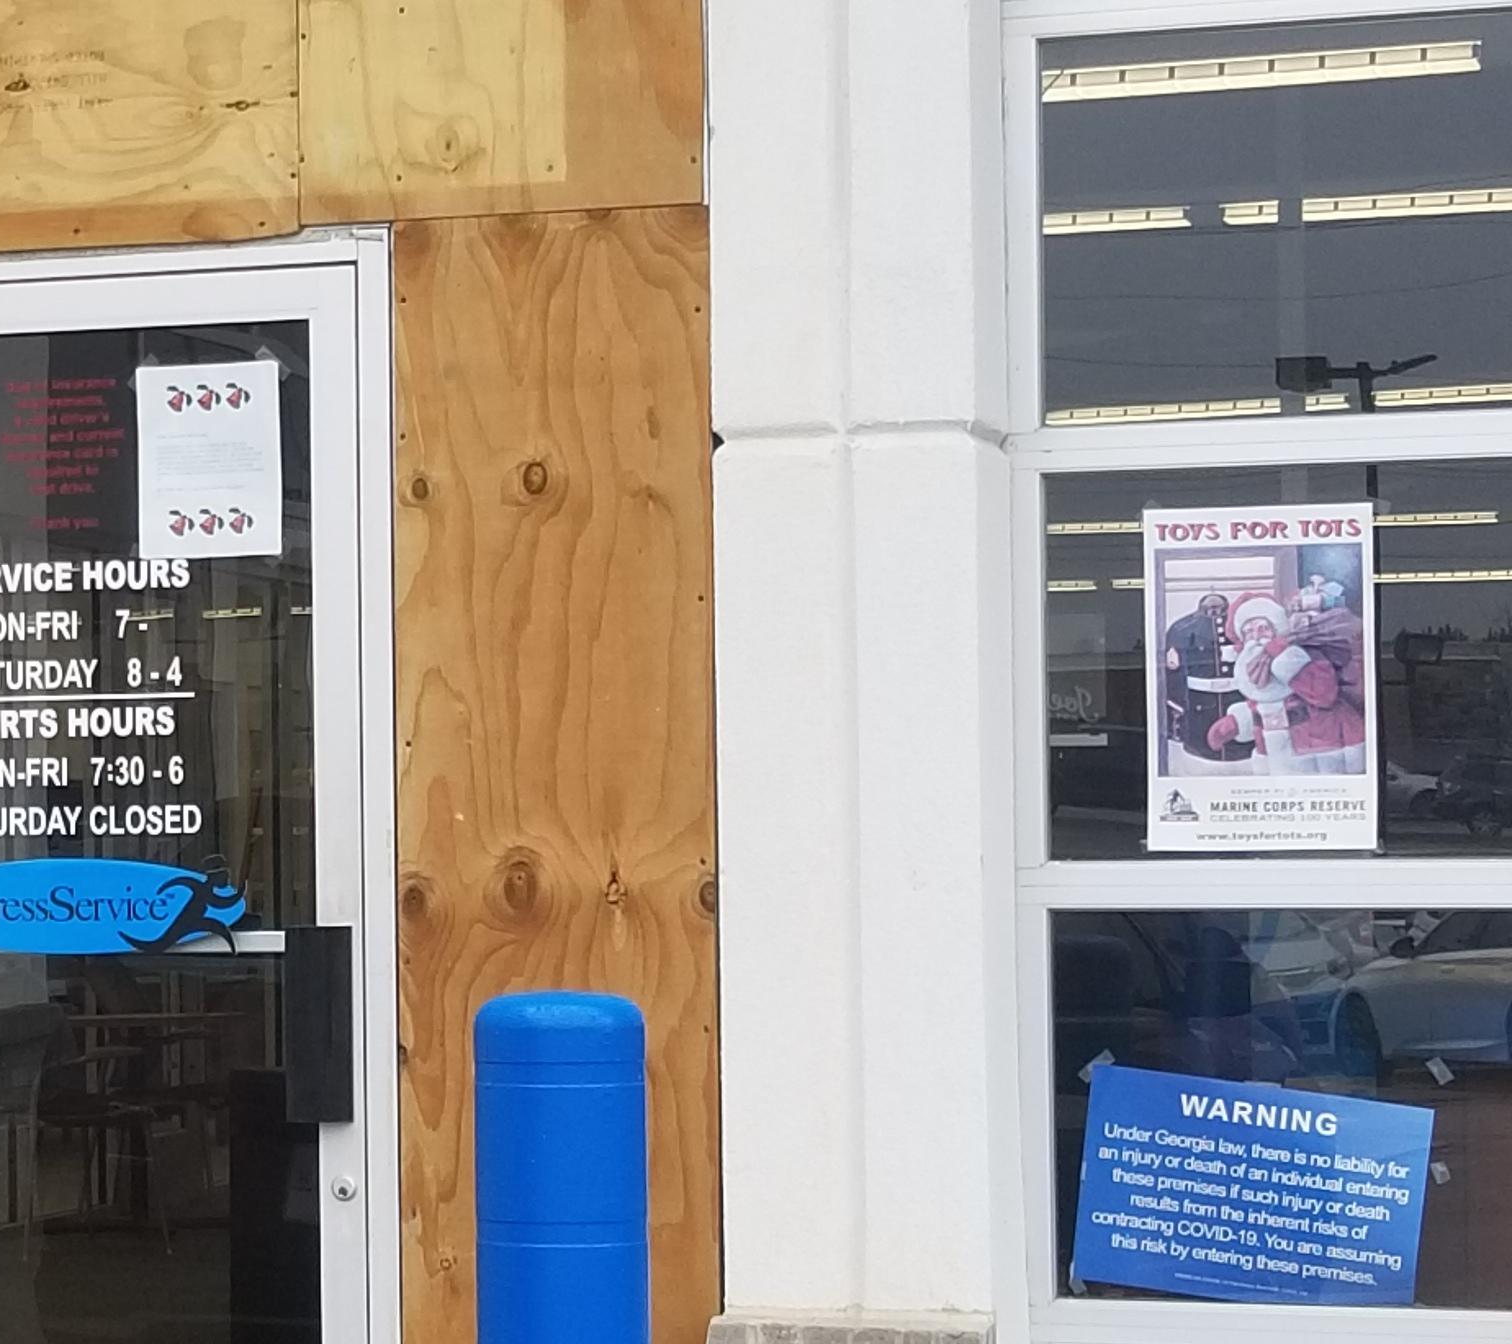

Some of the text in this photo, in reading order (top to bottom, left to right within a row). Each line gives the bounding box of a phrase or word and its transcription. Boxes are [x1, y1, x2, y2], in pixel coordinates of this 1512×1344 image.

[1154, 519, 1362, 542] TOYS FOR TOTS
[82, 558, 191, 591] HOURS
[115, 608, 131, 640] 7
[126, 657, 143, 688] 8
[165, 656, 183, 687] 4
[68, 706, 175, 738] HOURS
[90, 755, 145, 786] 7:30
[167, 755, 185, 786] 6
[89, 804, 203, 836] CLOSED
[1209, 813, 1295, 823] CELEBRATING
[1325, 812, 1366, 822] YEARS
[1210, 800, 1366, 813] MARINE CORPS RESERVE
[1180, 1094, 1337, 1136] WARNING
[1104, 1122, 1410, 1179] Under Georgia law, there is no liability for
[1098, 1146, 1410, 1205] an injury or death of an individual entering
[1112, 1167, 1391, 1221] these premises if such injury or death
[1130, 1194, 1369, 1240] results from the inherent risks of
[1091, 1211, 1402, 1271] contracting COVID-19. You are assuming
[1111, 1233, 1137, 1250] this
[1140, 1237, 1167, 1254] risk
[1170, 1240, 1189, 1261] by
[1192, 1247, 1253, 1270] entering
[1256, 1254, 1299, 1274] these
[1302, 1264, 1378, 1286] premises.
